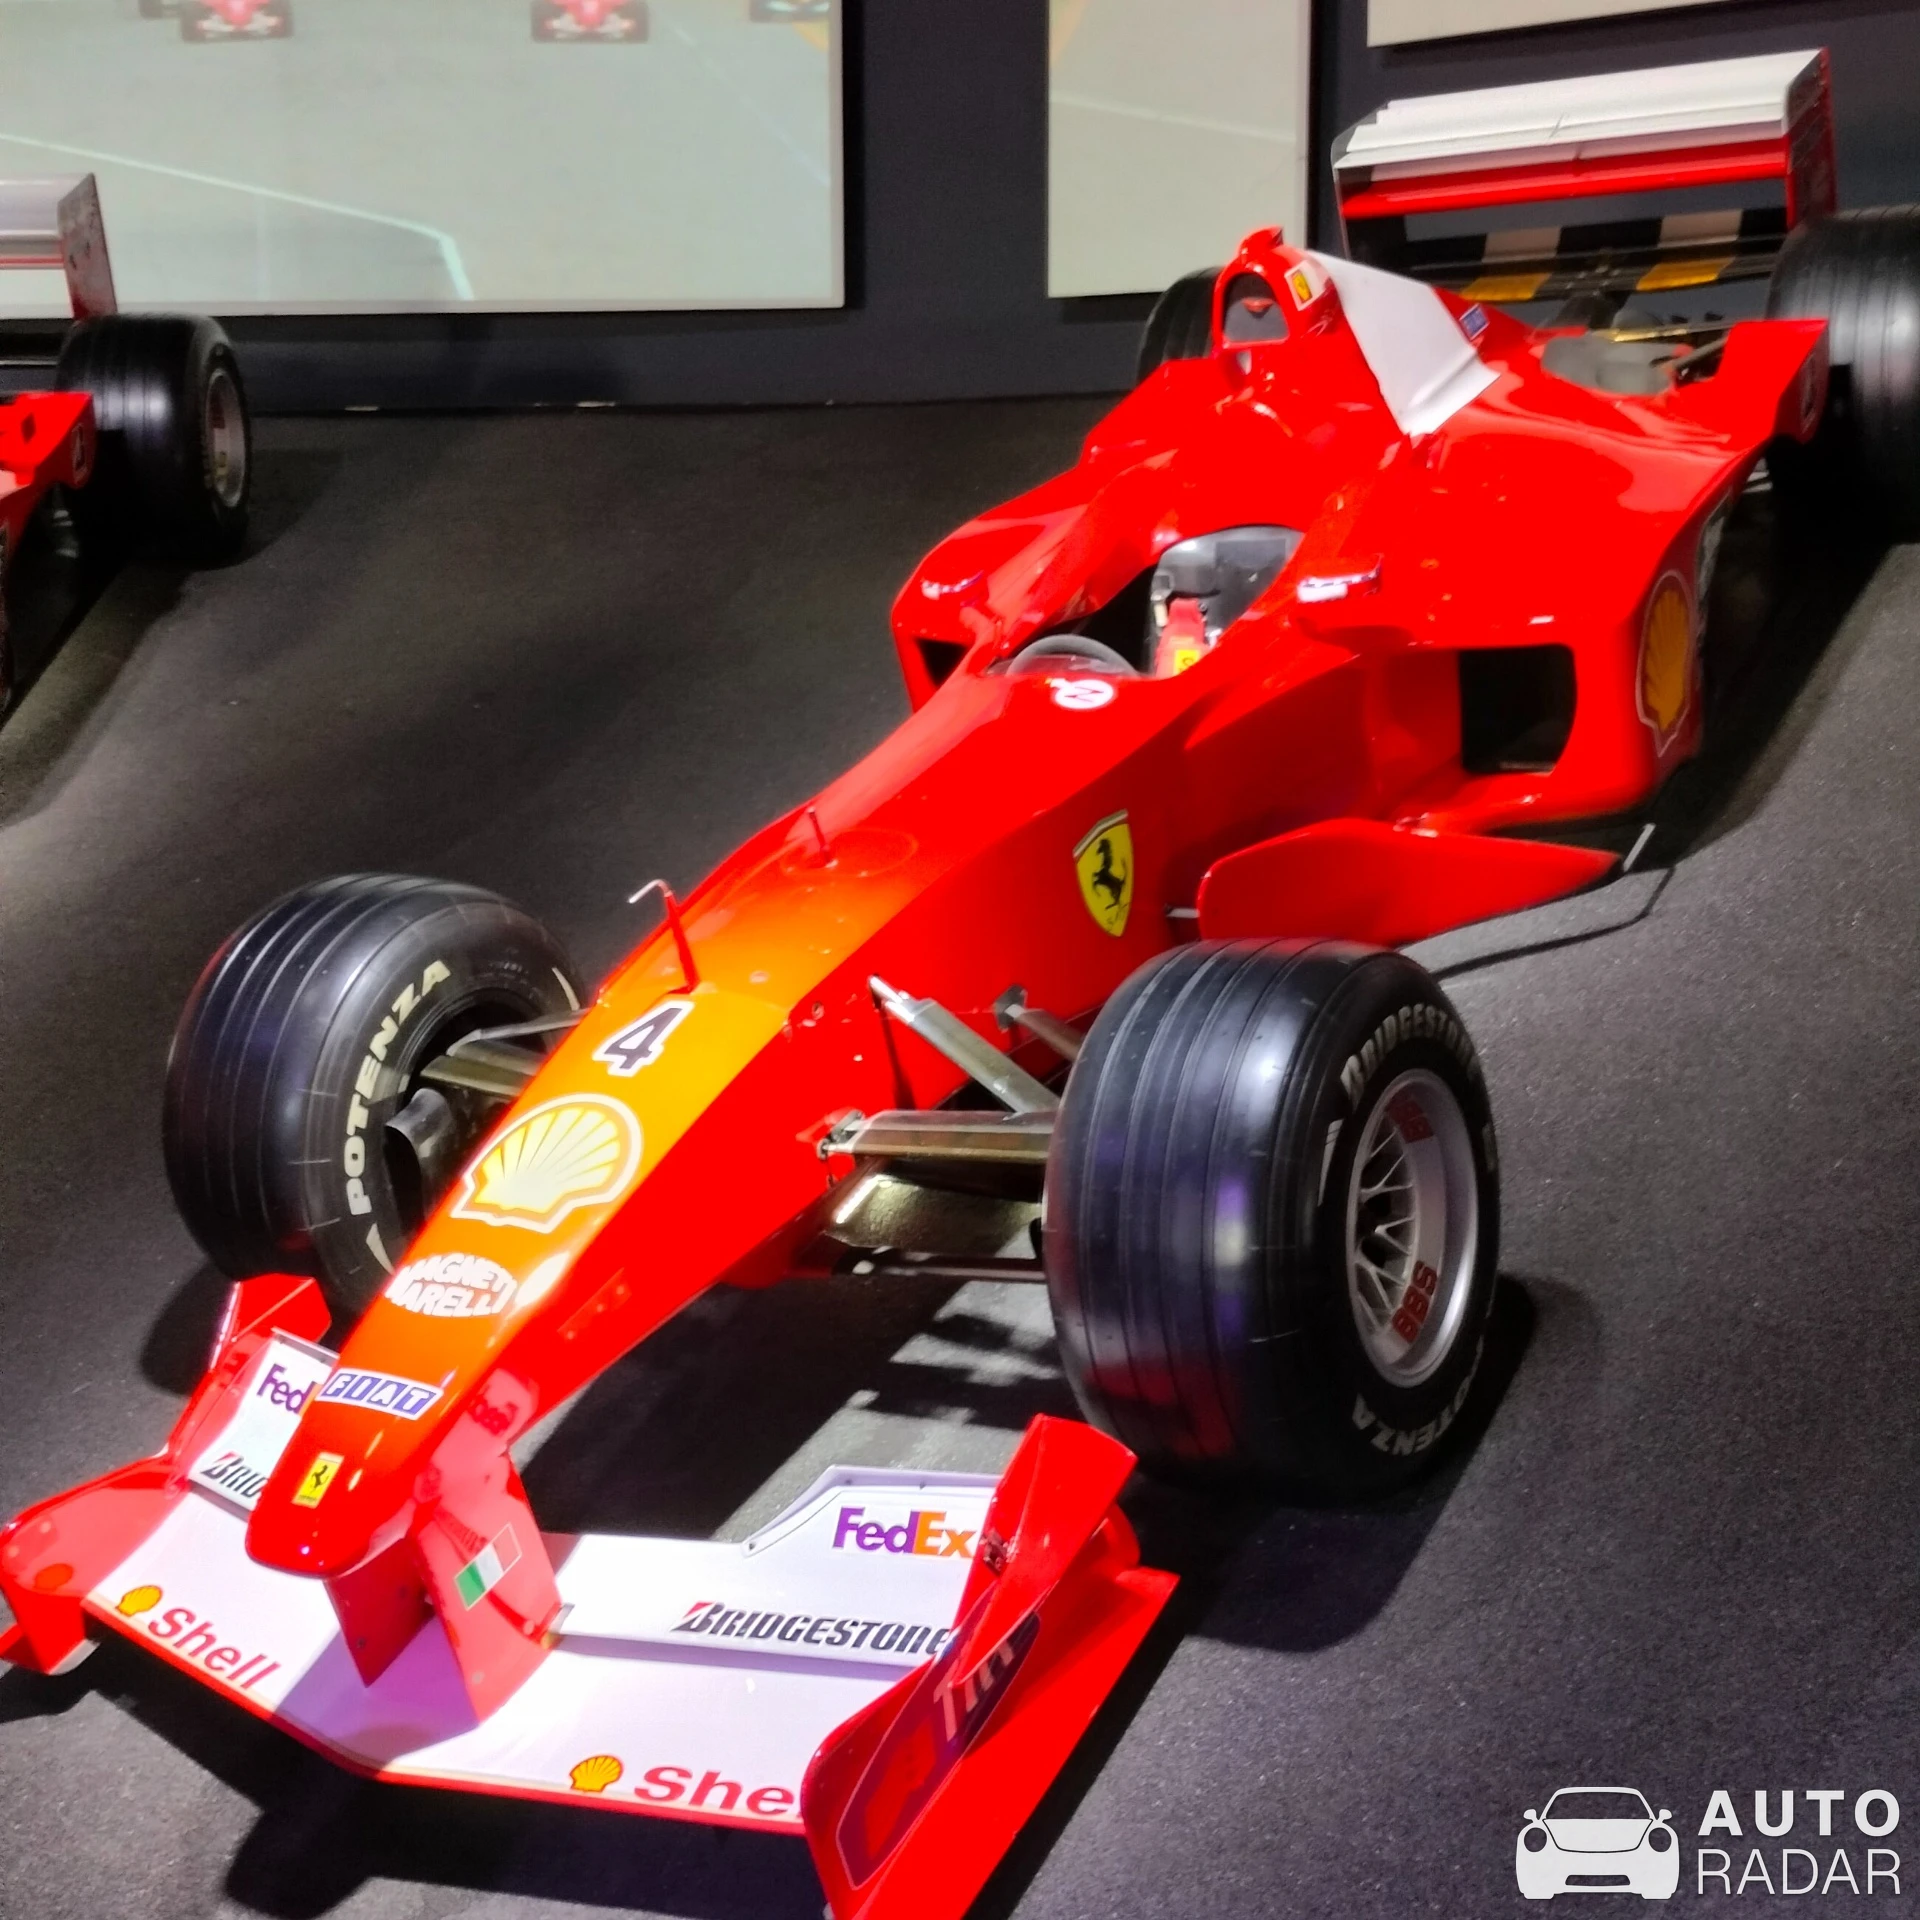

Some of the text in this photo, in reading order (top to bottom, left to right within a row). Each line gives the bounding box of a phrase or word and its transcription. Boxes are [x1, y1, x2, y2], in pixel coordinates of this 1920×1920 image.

[602, 1006, 684, 1071] 4
[344, 960, 451, 1216] POTENZA
[1391, 1261, 1438, 1344] BBS
[256, 1363, 322, 1416] Fed
[322, 1372, 436, 1414] FIAT
[1351, 1362, 1478, 1457] OTENZA
[832, 1506, 976, 1558] FedEx
[148, 1607, 281, 1690] Shell
[634, 1766, 802, 1818] She
